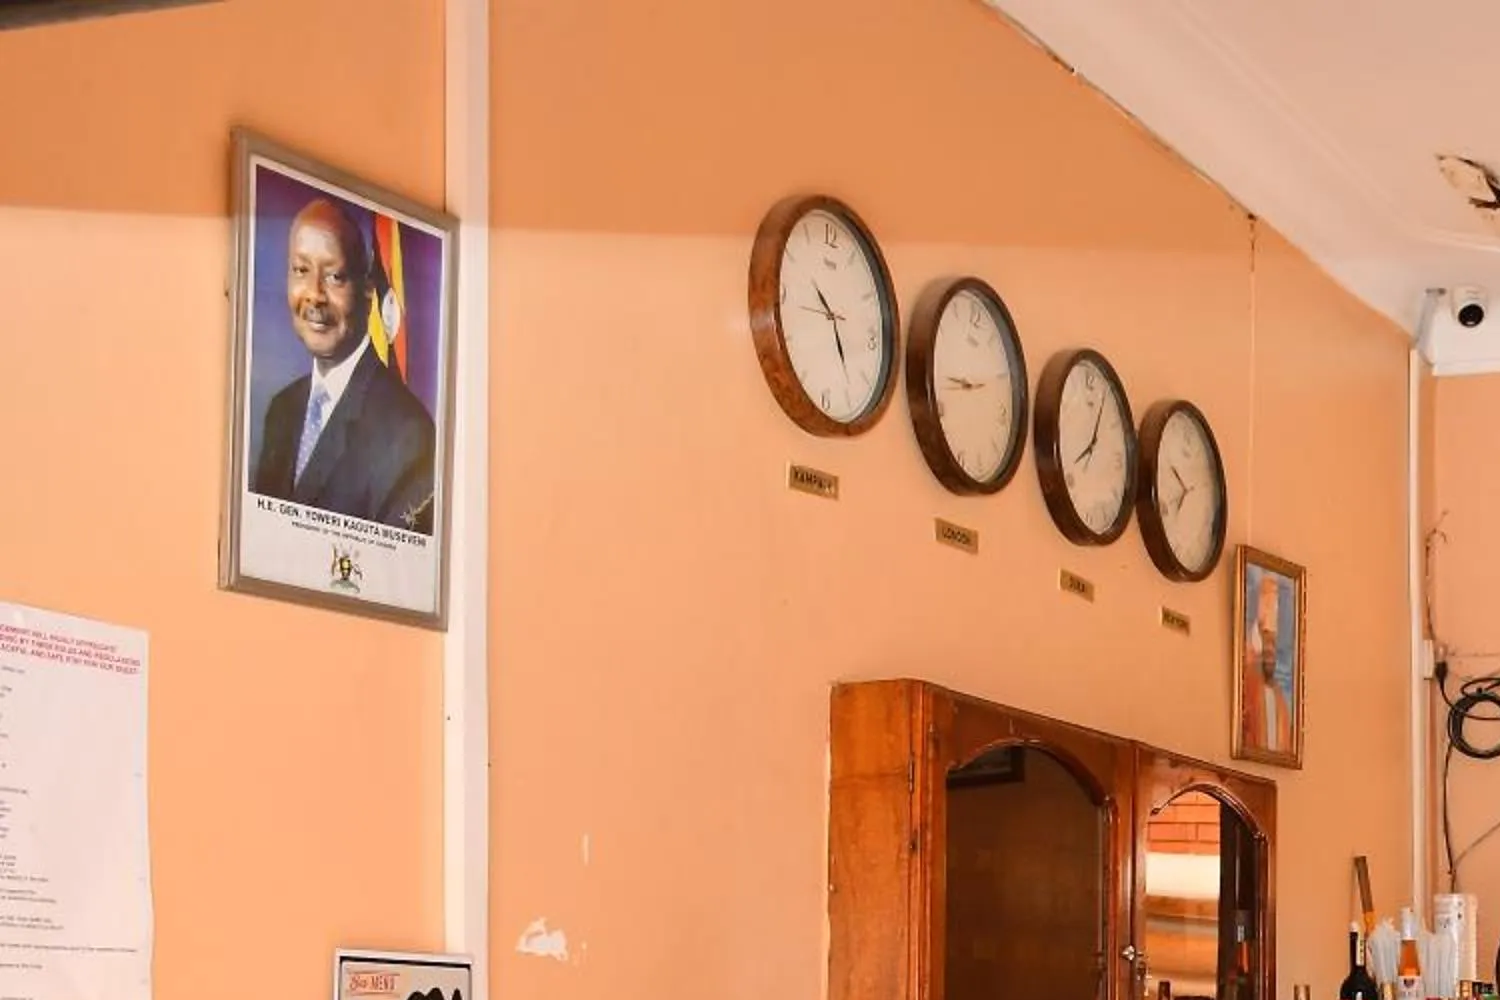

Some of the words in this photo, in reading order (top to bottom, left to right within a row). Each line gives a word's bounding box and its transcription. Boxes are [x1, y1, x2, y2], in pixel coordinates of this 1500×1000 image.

[824, 223, 839, 249] 12
[305, 510, 341, 526] YOWERI
[343, 518, 380, 537] KAGUTA
